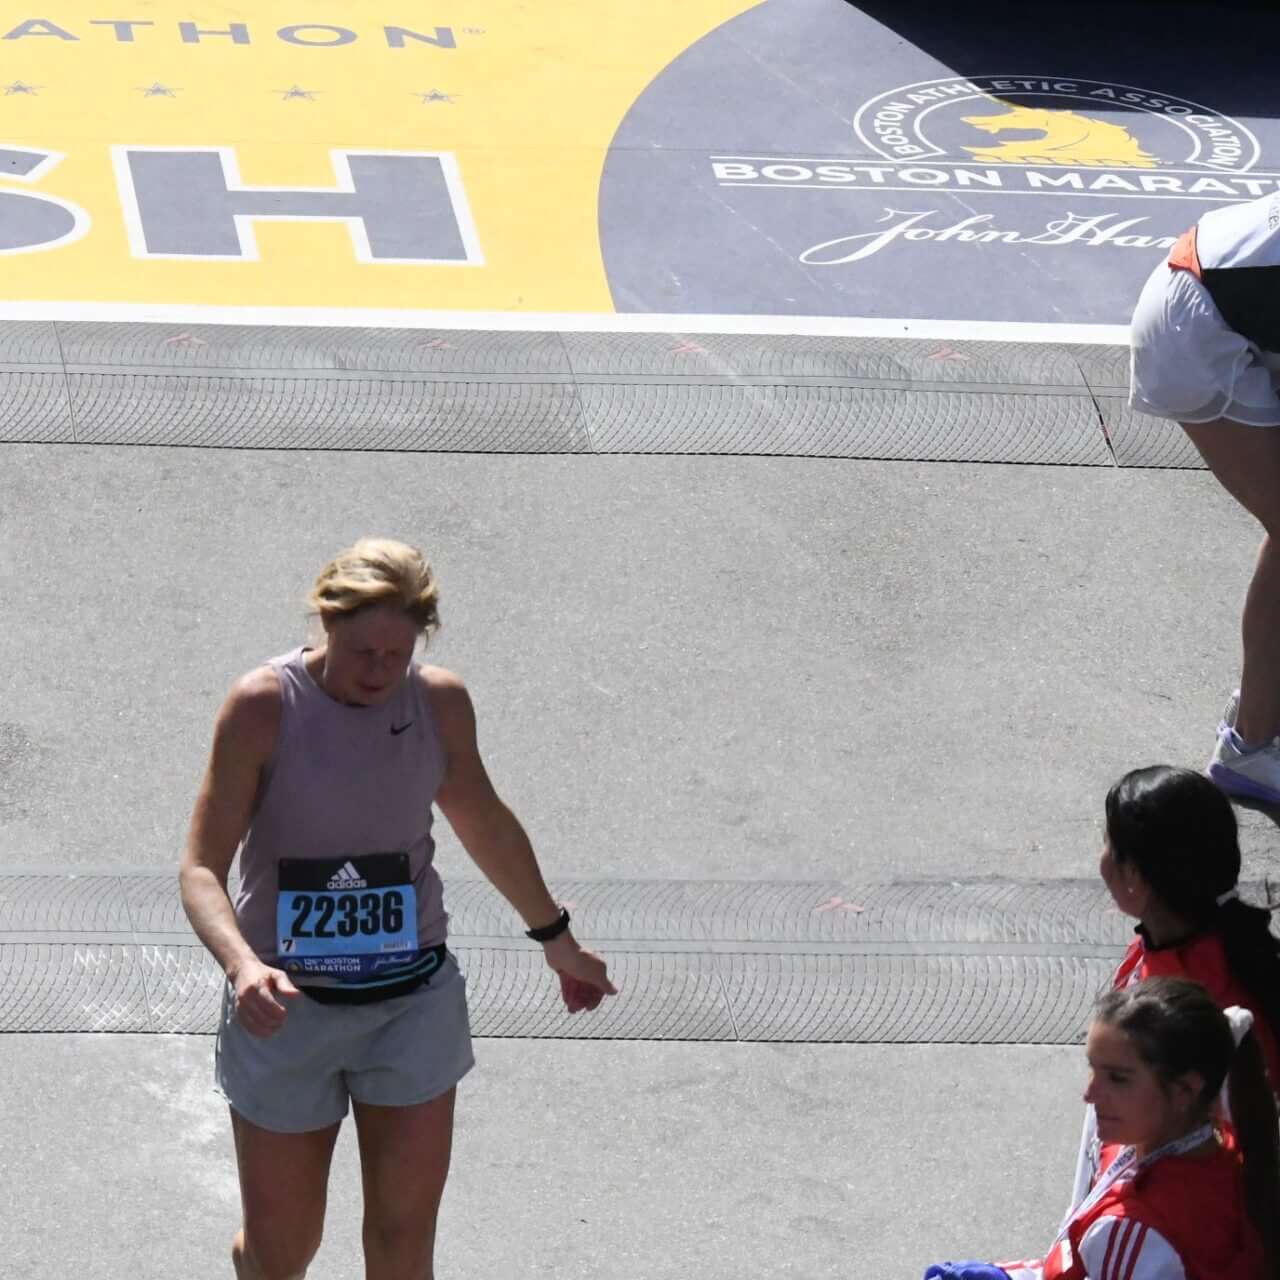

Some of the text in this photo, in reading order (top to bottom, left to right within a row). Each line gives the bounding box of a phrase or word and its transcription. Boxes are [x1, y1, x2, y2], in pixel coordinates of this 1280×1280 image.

[874, 80, 1242, 167] BOSTON ATHLETIC ASSOCIATION
[713, 163, 1002, 186] BOSTON
[800, 208, 1020, 264] John
[327, 879, 367, 890] adidas
[291, 890, 404, 938] 22336
[283, 939, 293, 952] 7
[324, 957, 360, 965] BOSTON
